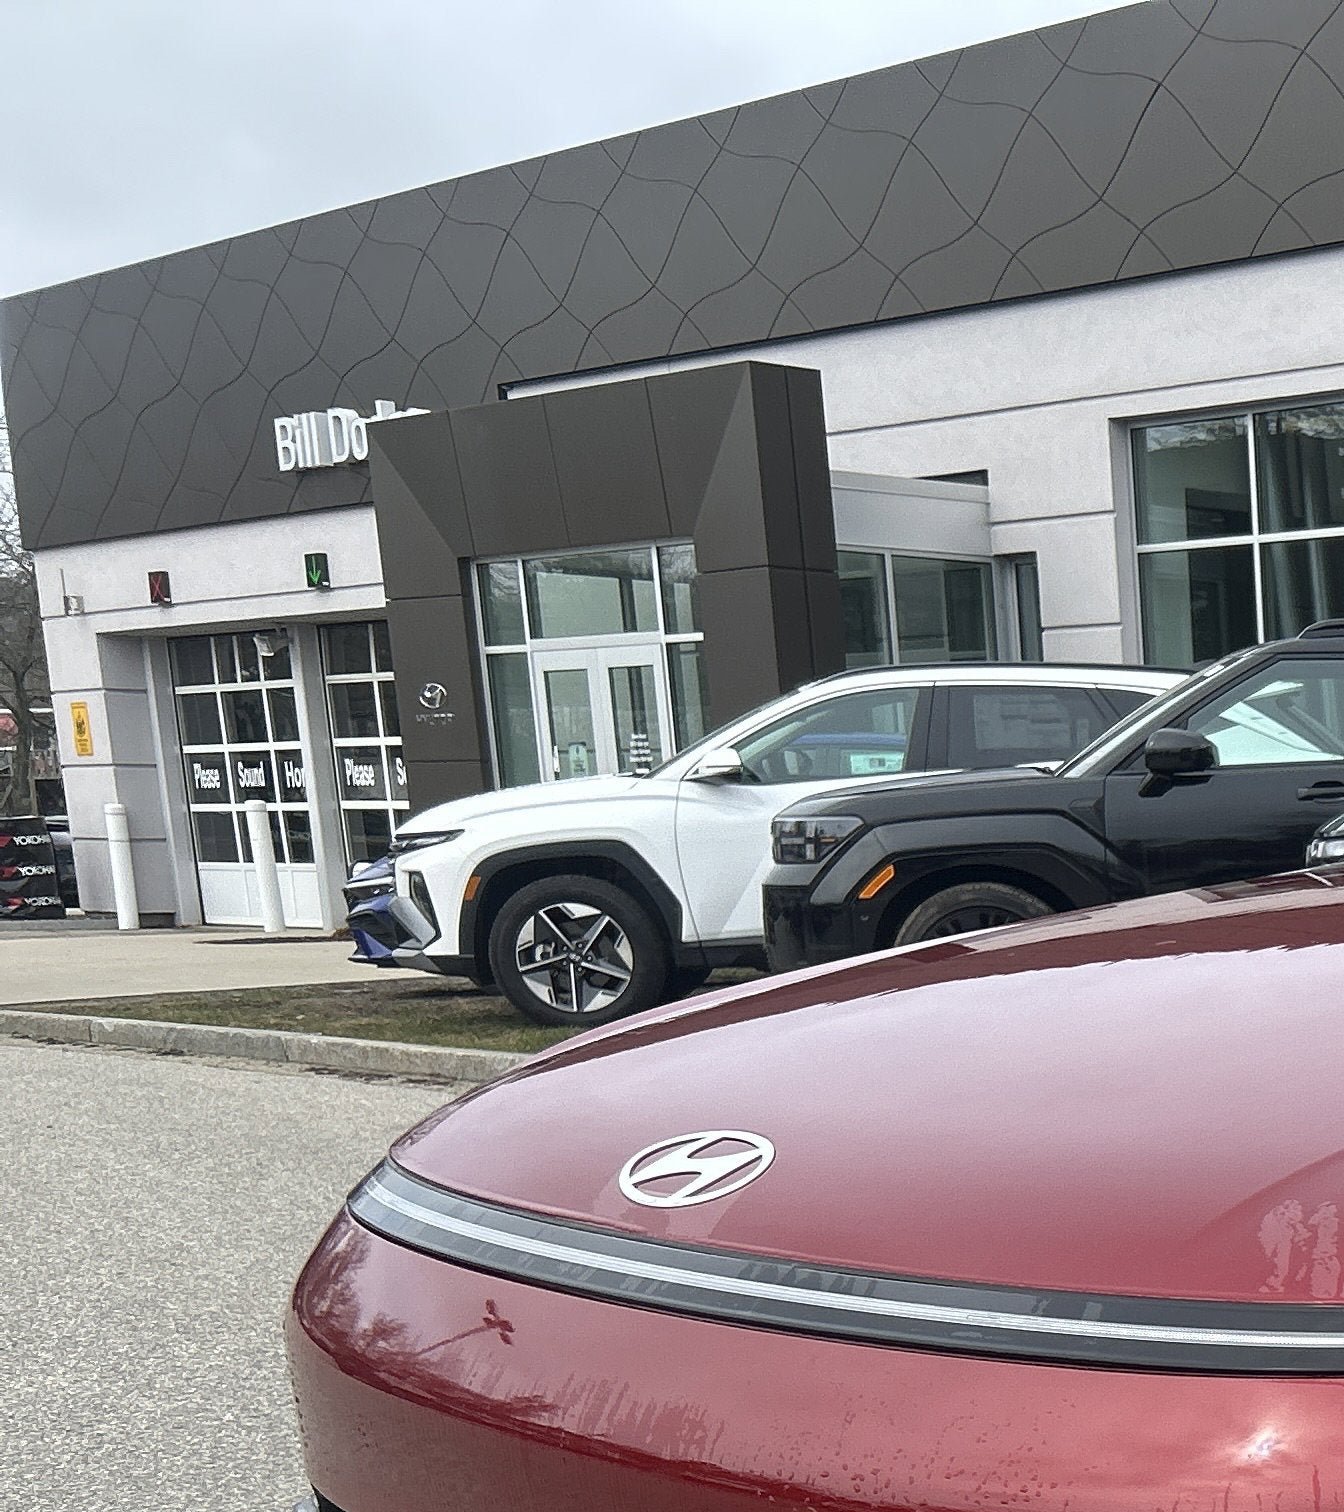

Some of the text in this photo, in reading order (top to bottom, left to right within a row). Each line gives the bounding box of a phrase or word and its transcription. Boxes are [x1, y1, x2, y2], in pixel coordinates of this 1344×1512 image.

[274, 412, 328, 472] Bill
[192, 762, 221, 789] Please
[237, 760, 266, 788] Sound
[344, 757, 375, 788] Please
